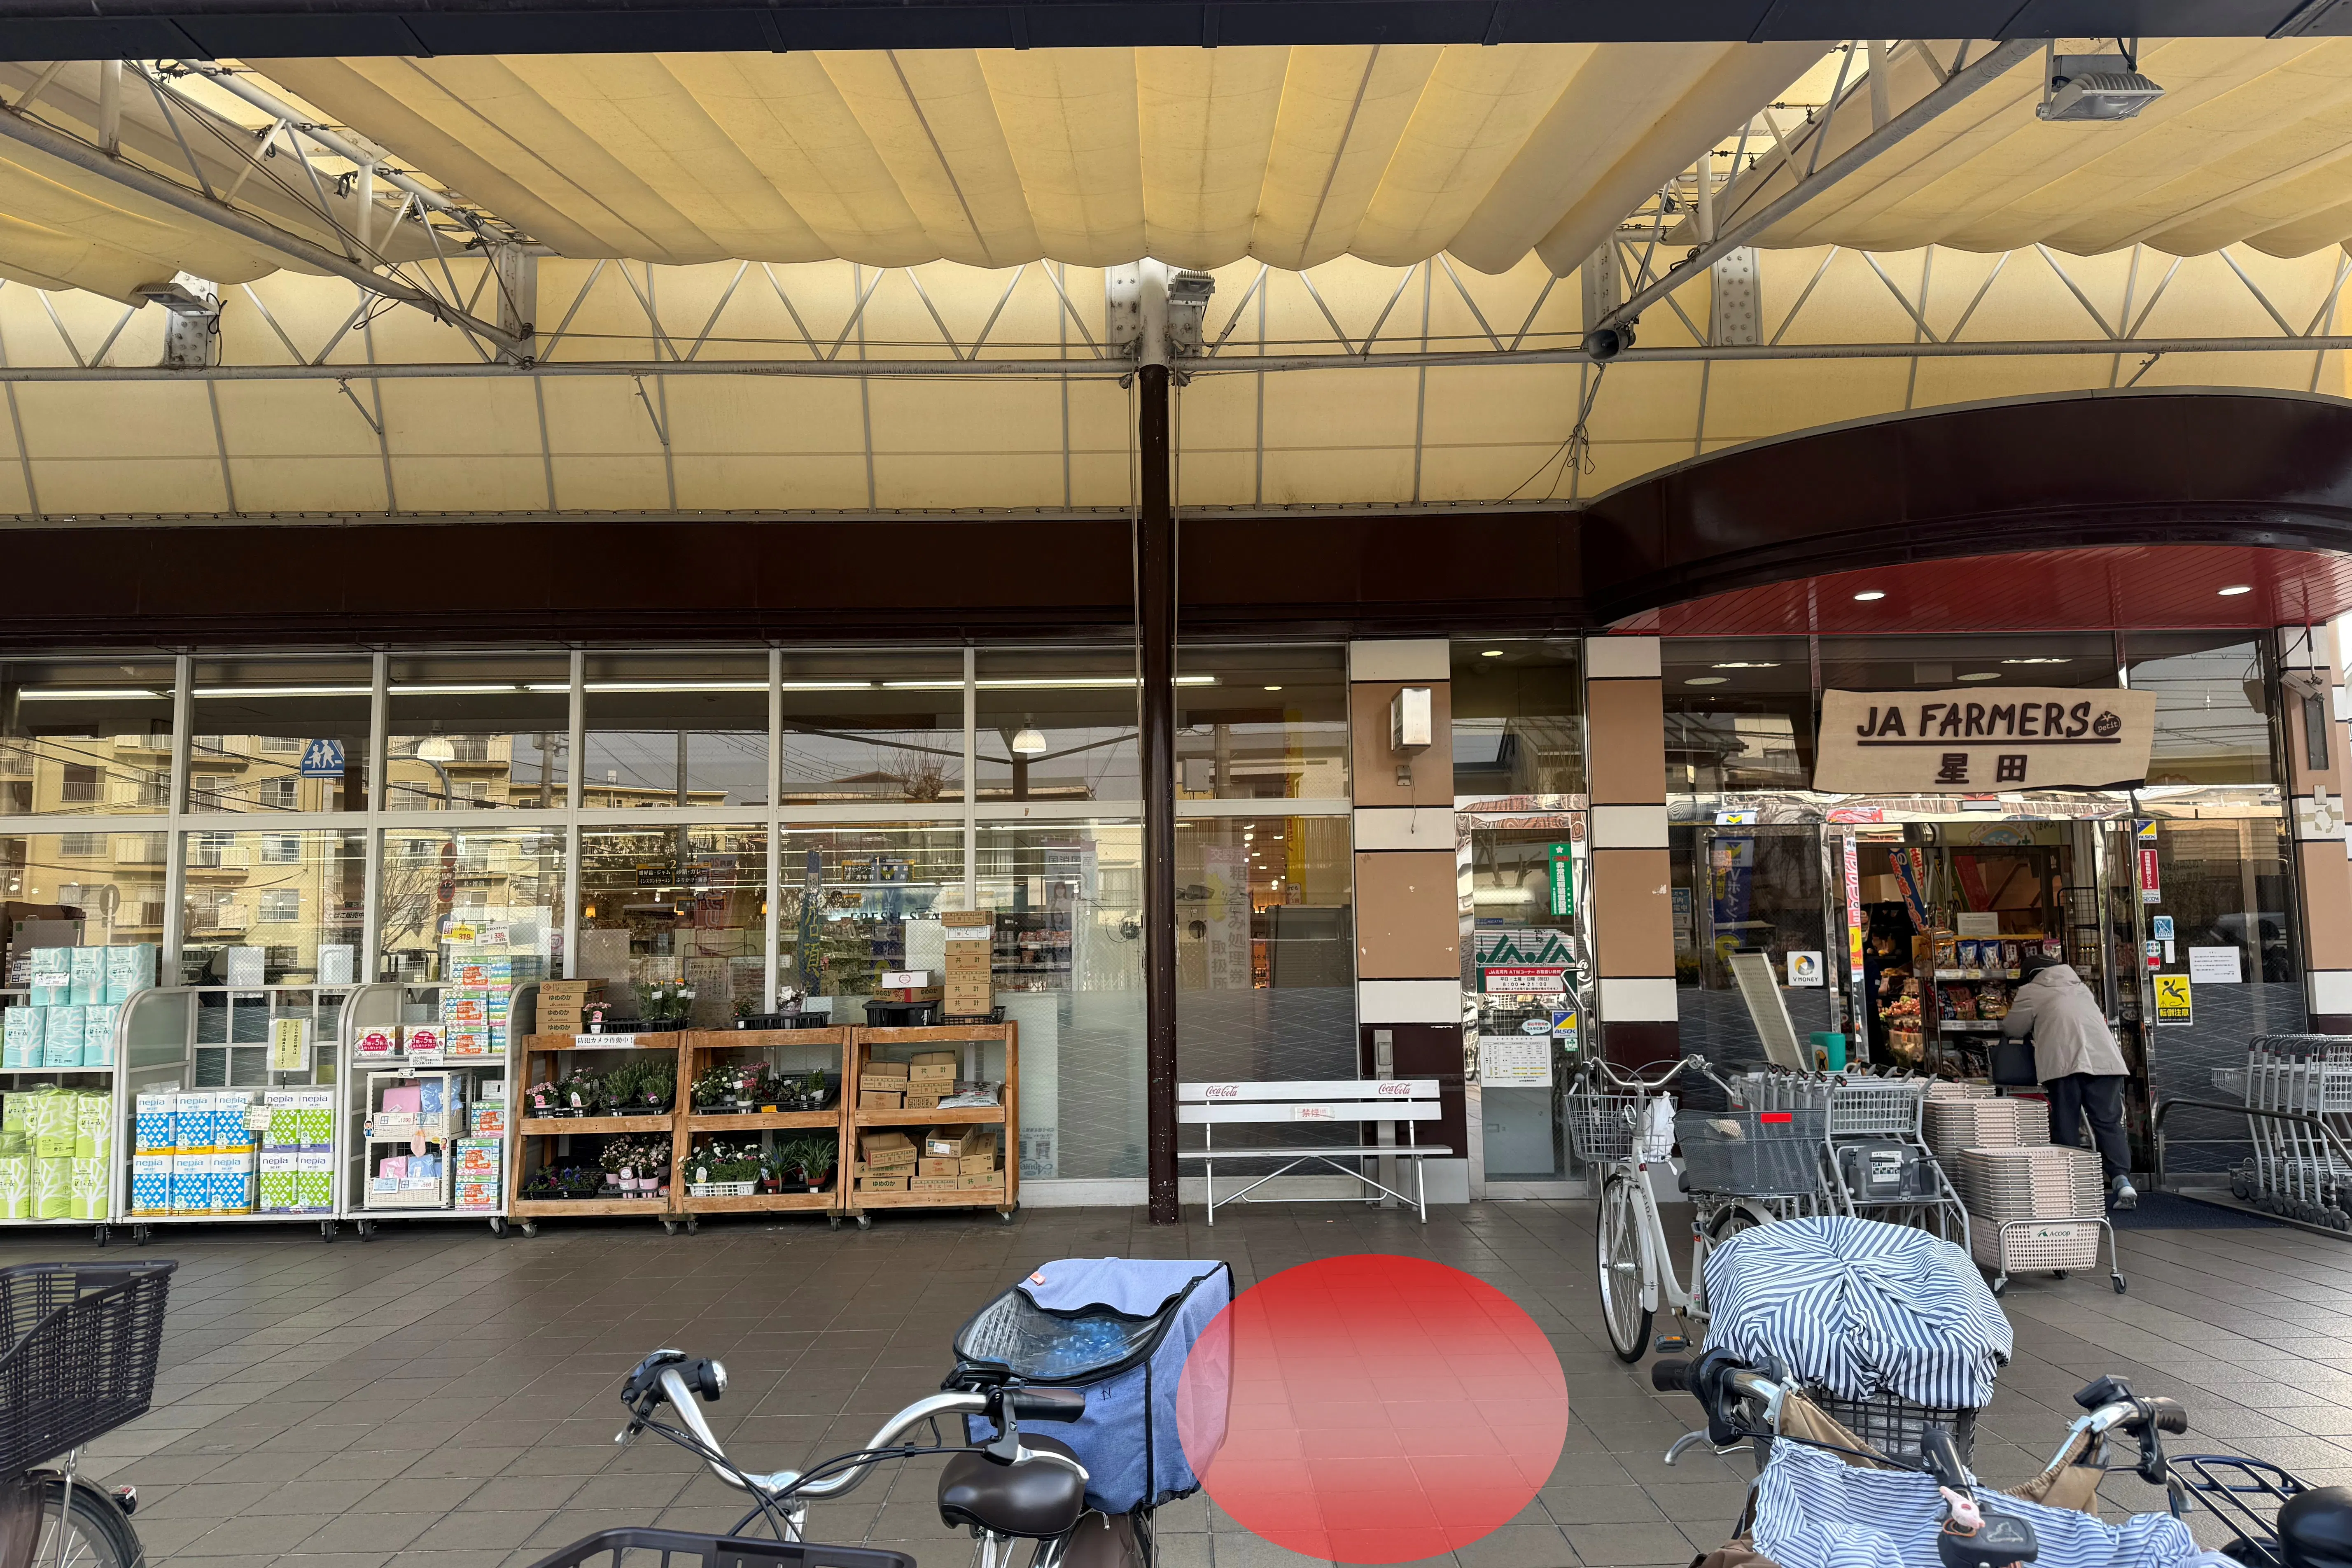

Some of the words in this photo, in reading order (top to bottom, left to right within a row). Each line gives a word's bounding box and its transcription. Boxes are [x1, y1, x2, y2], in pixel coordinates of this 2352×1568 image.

[1857, 707, 1906, 737] JA
[1919, 701, 2091, 737] FARMERS
[2098, 720, 2119, 733] petit
[1935, 753, 2027, 784] 星田
[670, 859, 677, 869] 2
[1206, 1085, 1239, 1097] Coca-Cola
[1378, 1083, 1412, 1095] Coca-Cola
